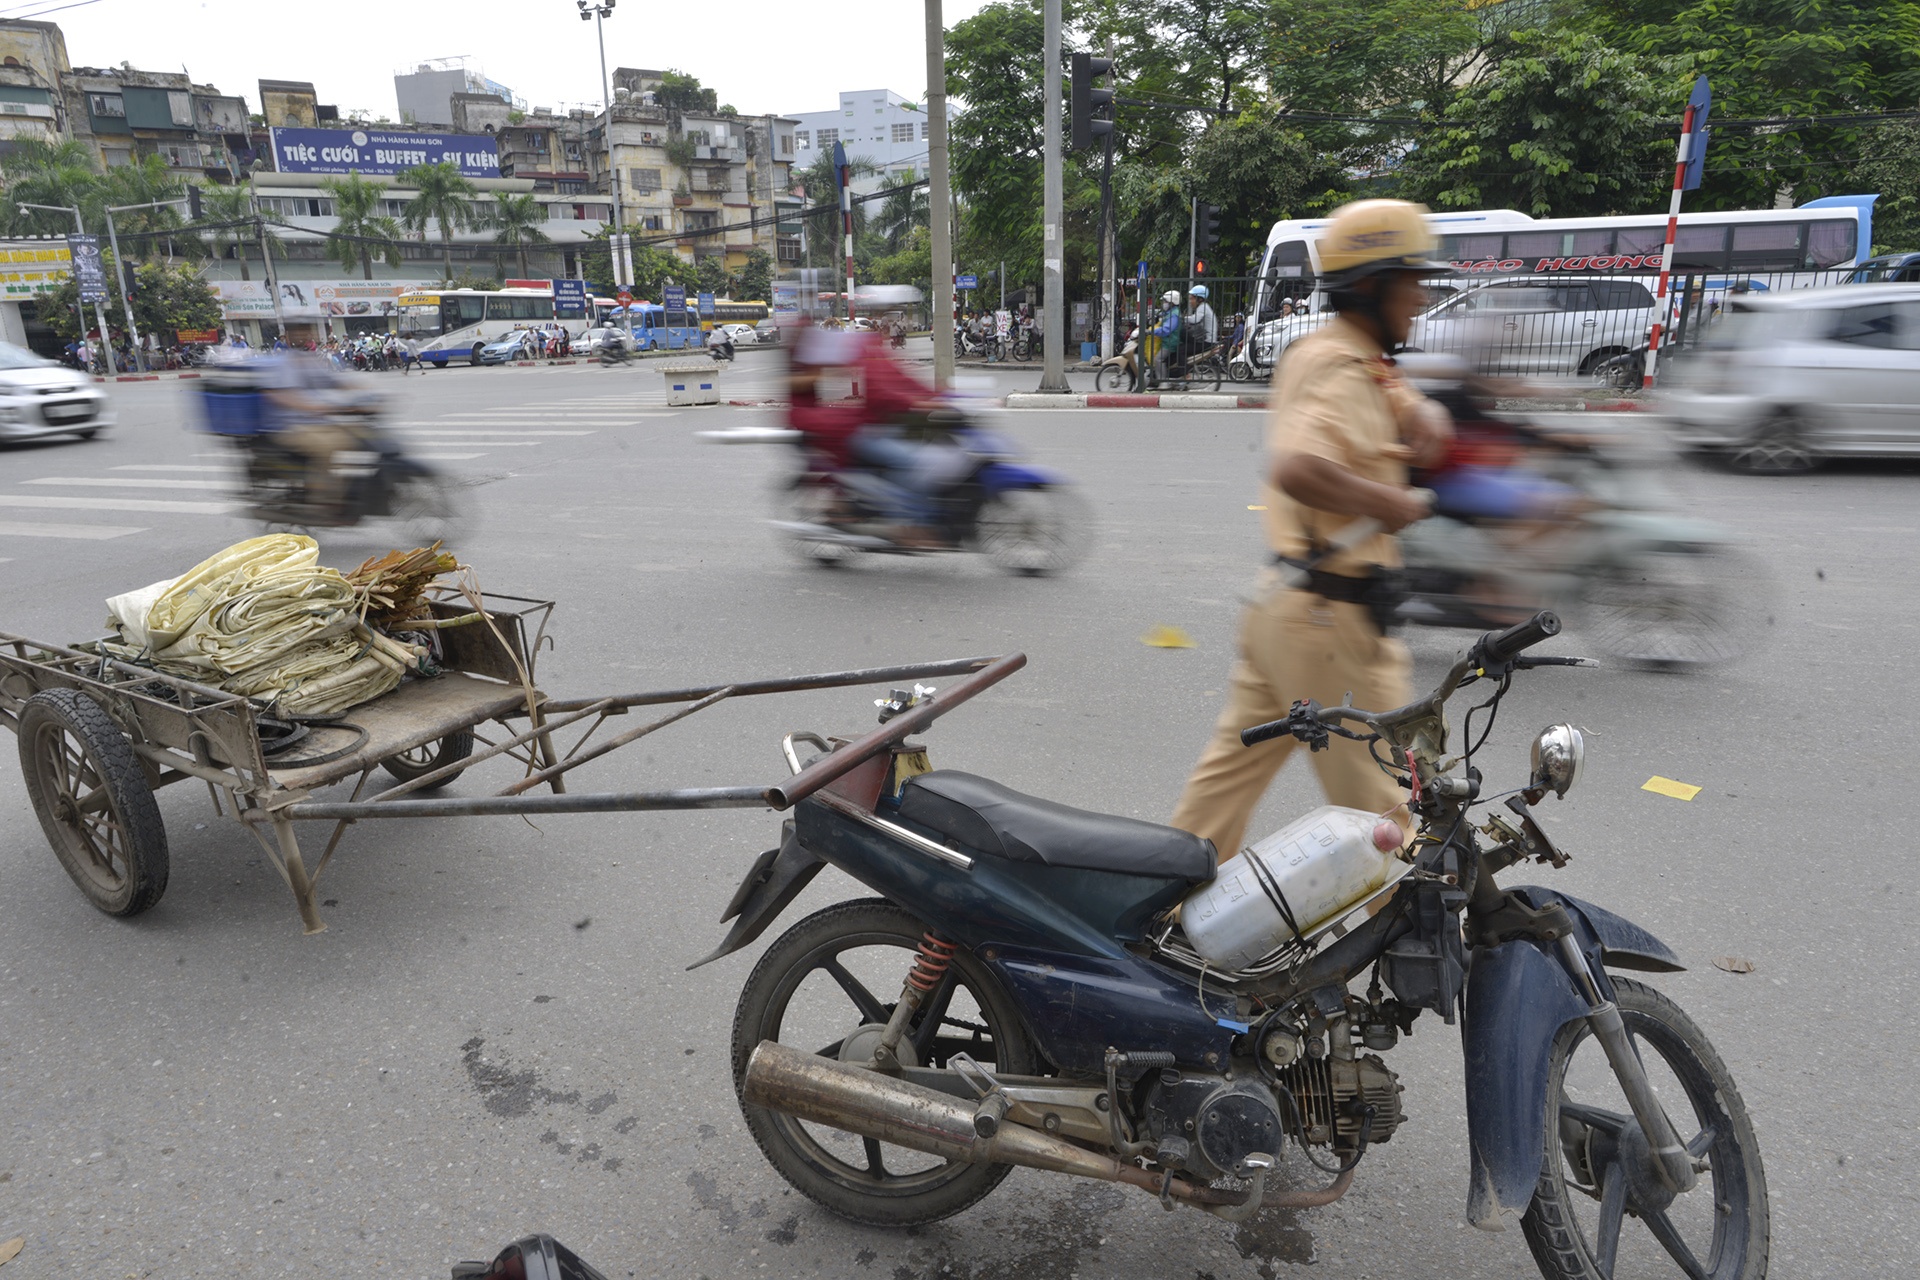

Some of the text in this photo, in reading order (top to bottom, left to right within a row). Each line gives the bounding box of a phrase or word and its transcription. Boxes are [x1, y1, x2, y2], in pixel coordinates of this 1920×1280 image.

[371, 135, 443, 146] NHÀ HÀNG NAM SƠN
[283, 142, 317, 165] TIỆC
[321, 145, 359, 163] CƯỚI
[375, 149, 426, 165] BUFFET
[465, 149, 499, 171] KIỆN
[1534, 254, 1664, 273] HƯƠNG
